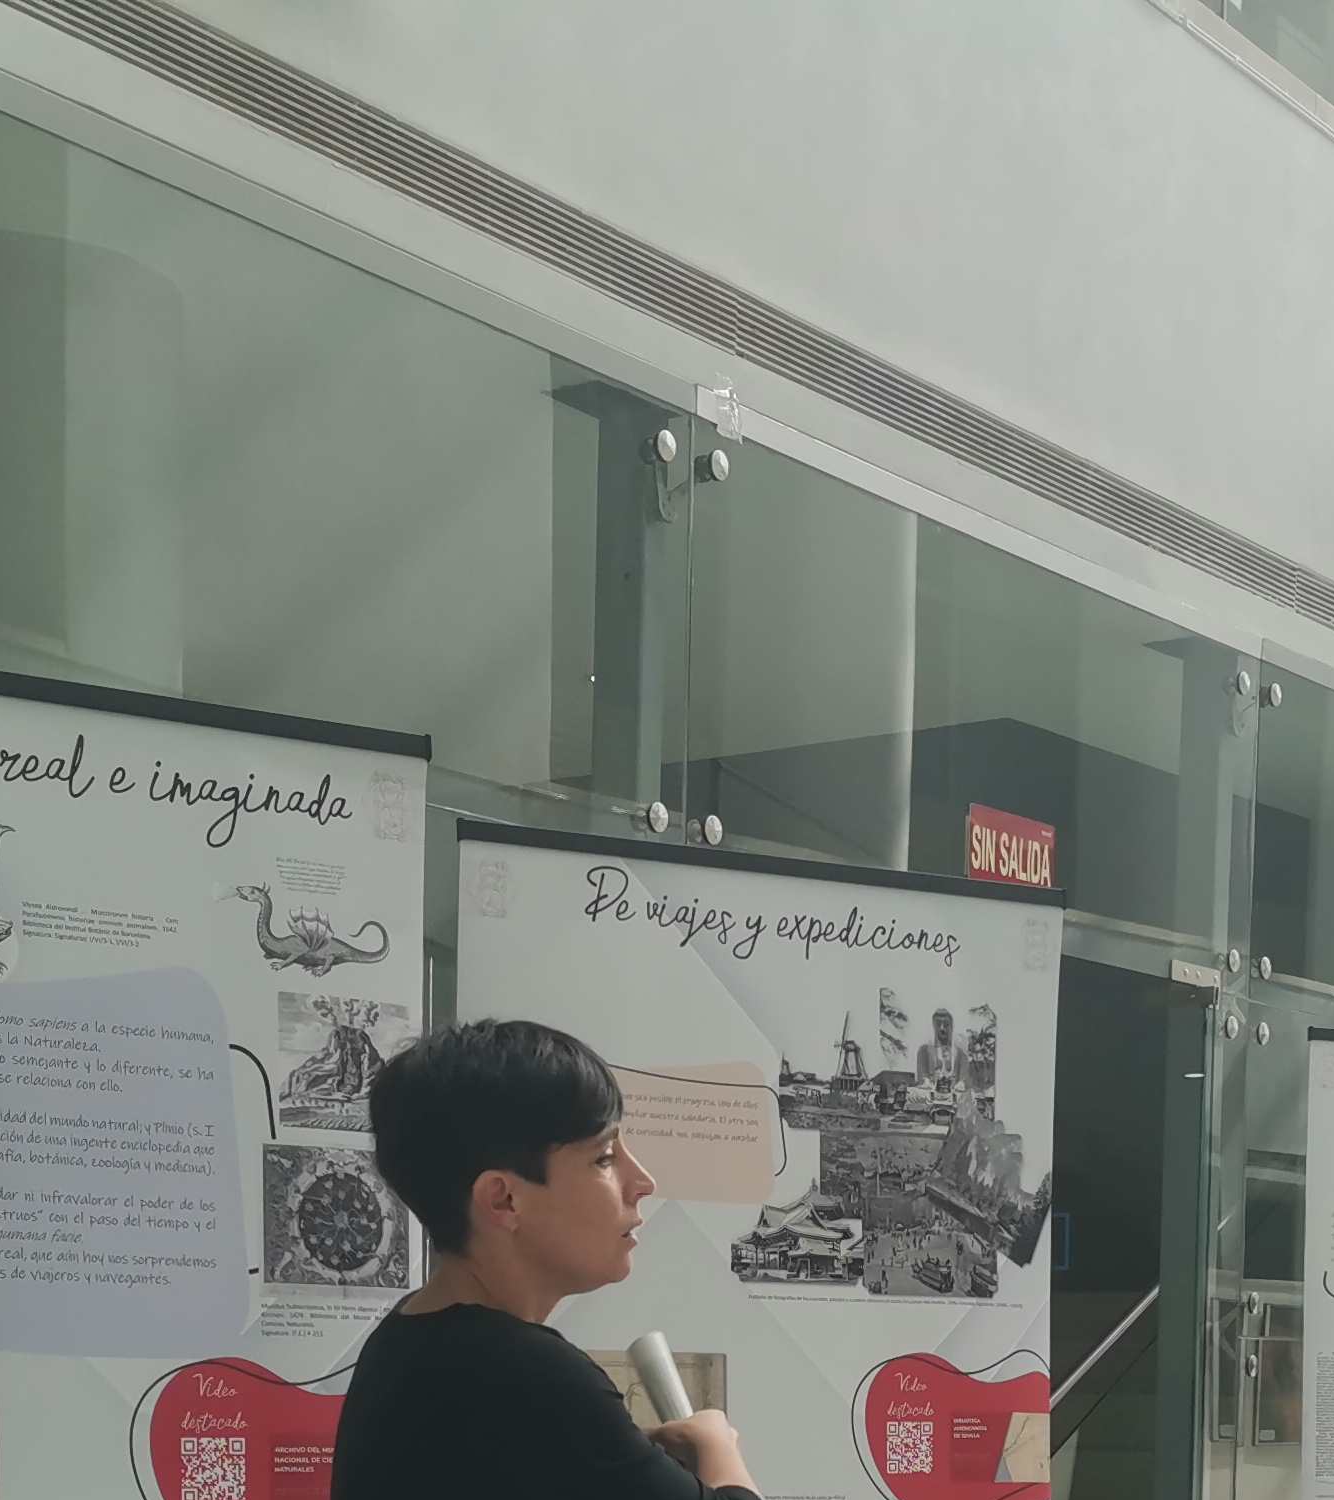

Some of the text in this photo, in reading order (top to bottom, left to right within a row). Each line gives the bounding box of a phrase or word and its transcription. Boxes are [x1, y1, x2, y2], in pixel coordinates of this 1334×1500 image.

[0, 735, 95, 798] real
[110, 765, 137, 793] e
[147, 760, 354, 849] imaginada
[971, 824, 1051, 887] SIN SALIDA
[584, 865, 961, 967] De viajes y expediciones
[28, 1017, 78, 1033] sapiens
[81, 1023, 90, 1032] a
[93, 1020, 106, 1035] la
[111, 1023, 156, 1040] especie
[161, 1026, 215, 1045] humana,
[30, 1251, 53, 1263] que
[82, 1250, 105, 1266] hoy
[108, 1255, 128, 1264] nos
[132, 1254, 217, 1269] sorprendemos
[10, 1266, 26, 1280] de
[29, 1269, 80, 1284] viajeros
[84, 1273, 92, 1285] y
[95, 1272, 172, 1287] navegantes.
[181, 1411, 249, 1434] destacado
[887, 1401, 935, 1419] destacado
